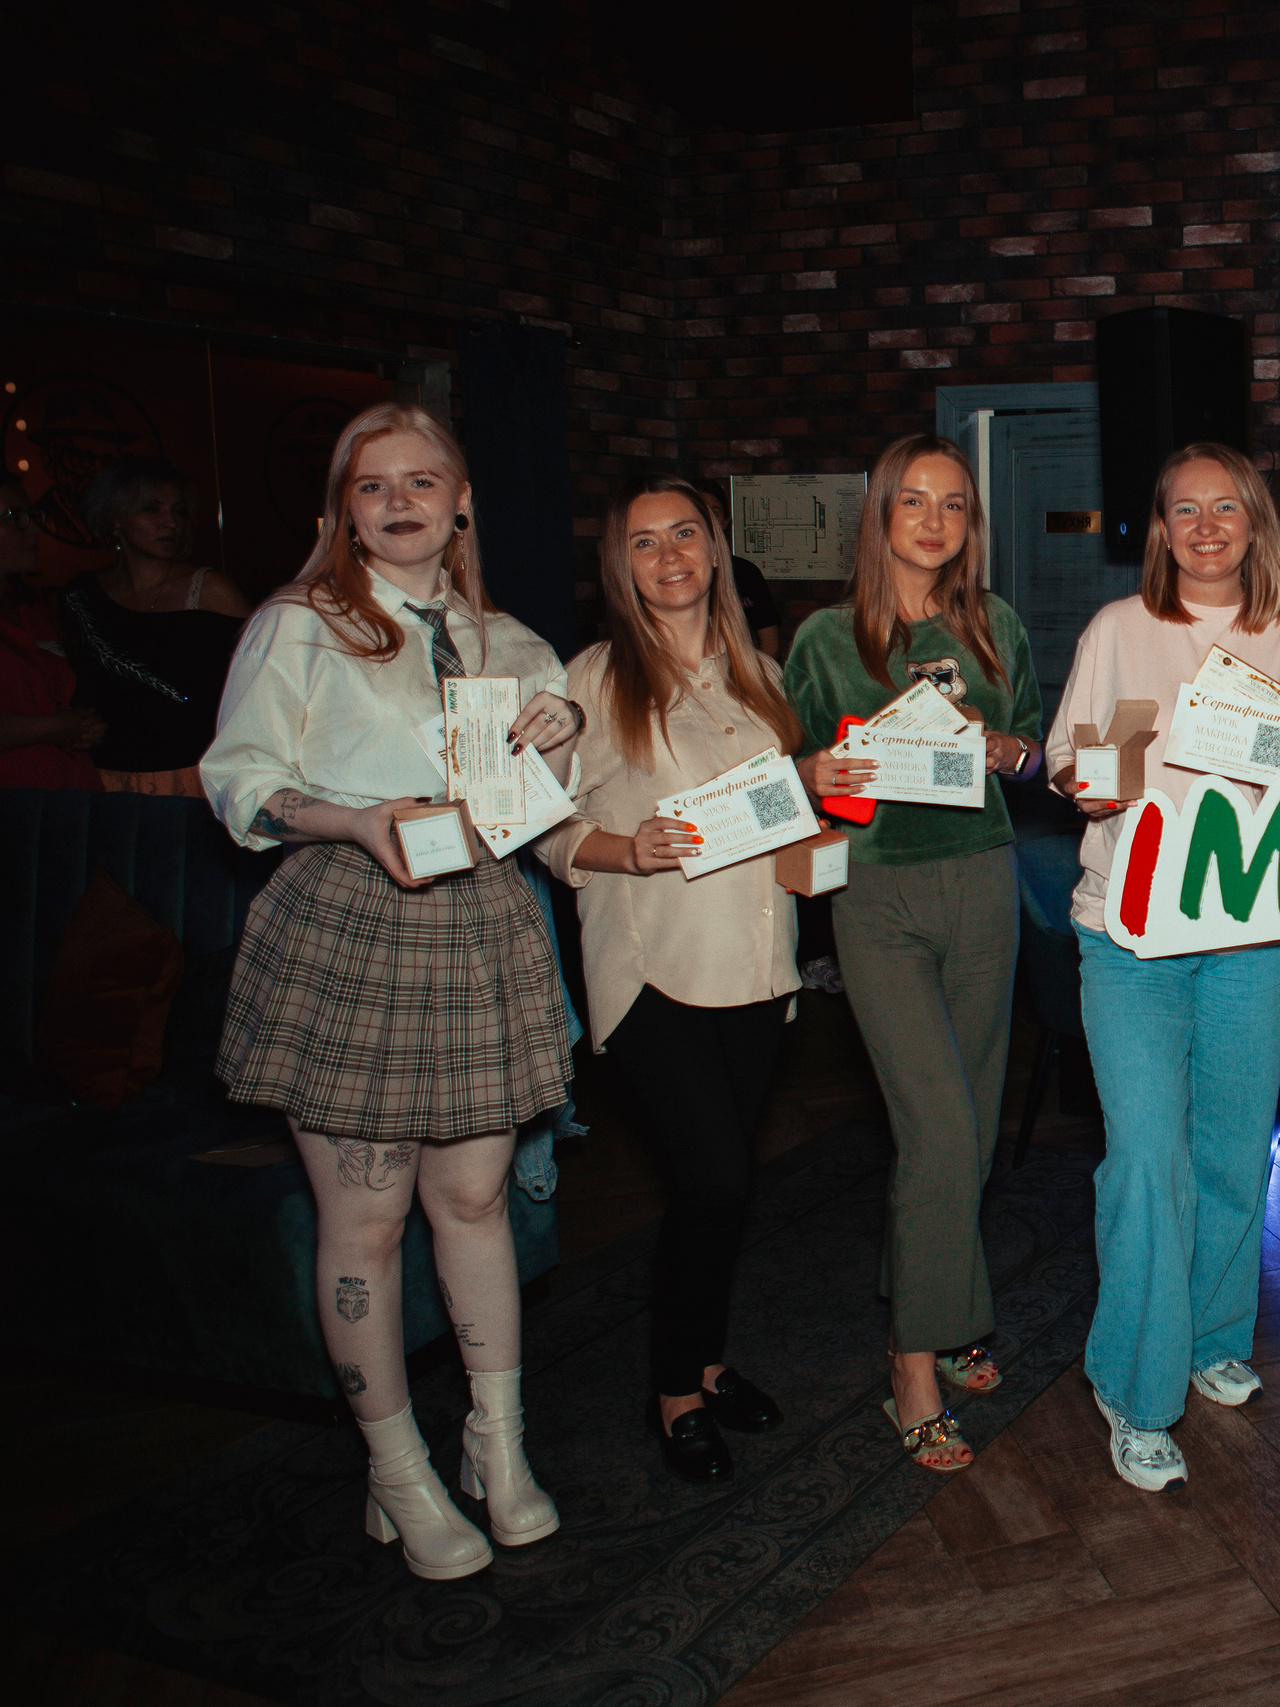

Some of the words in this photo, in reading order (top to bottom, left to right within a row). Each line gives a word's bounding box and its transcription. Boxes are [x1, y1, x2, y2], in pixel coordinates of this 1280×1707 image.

[1249, 680, 1279, 700] VOUCHER
[1212, 714, 1239, 729] УРОК
[872, 733, 959, 749] Сертификат
[1195, 725, 1249, 746] МАКИЯЖА
[888, 749, 915, 759] УРОК
[880, 760, 928, 772] АКИЯЖА
[898, 774, 926, 785] СЕБЯ
[683, 772, 769, 808] Сертификат
[702, 802, 731, 818] УРОК
[726, 826, 755, 843] СЕБЯ
